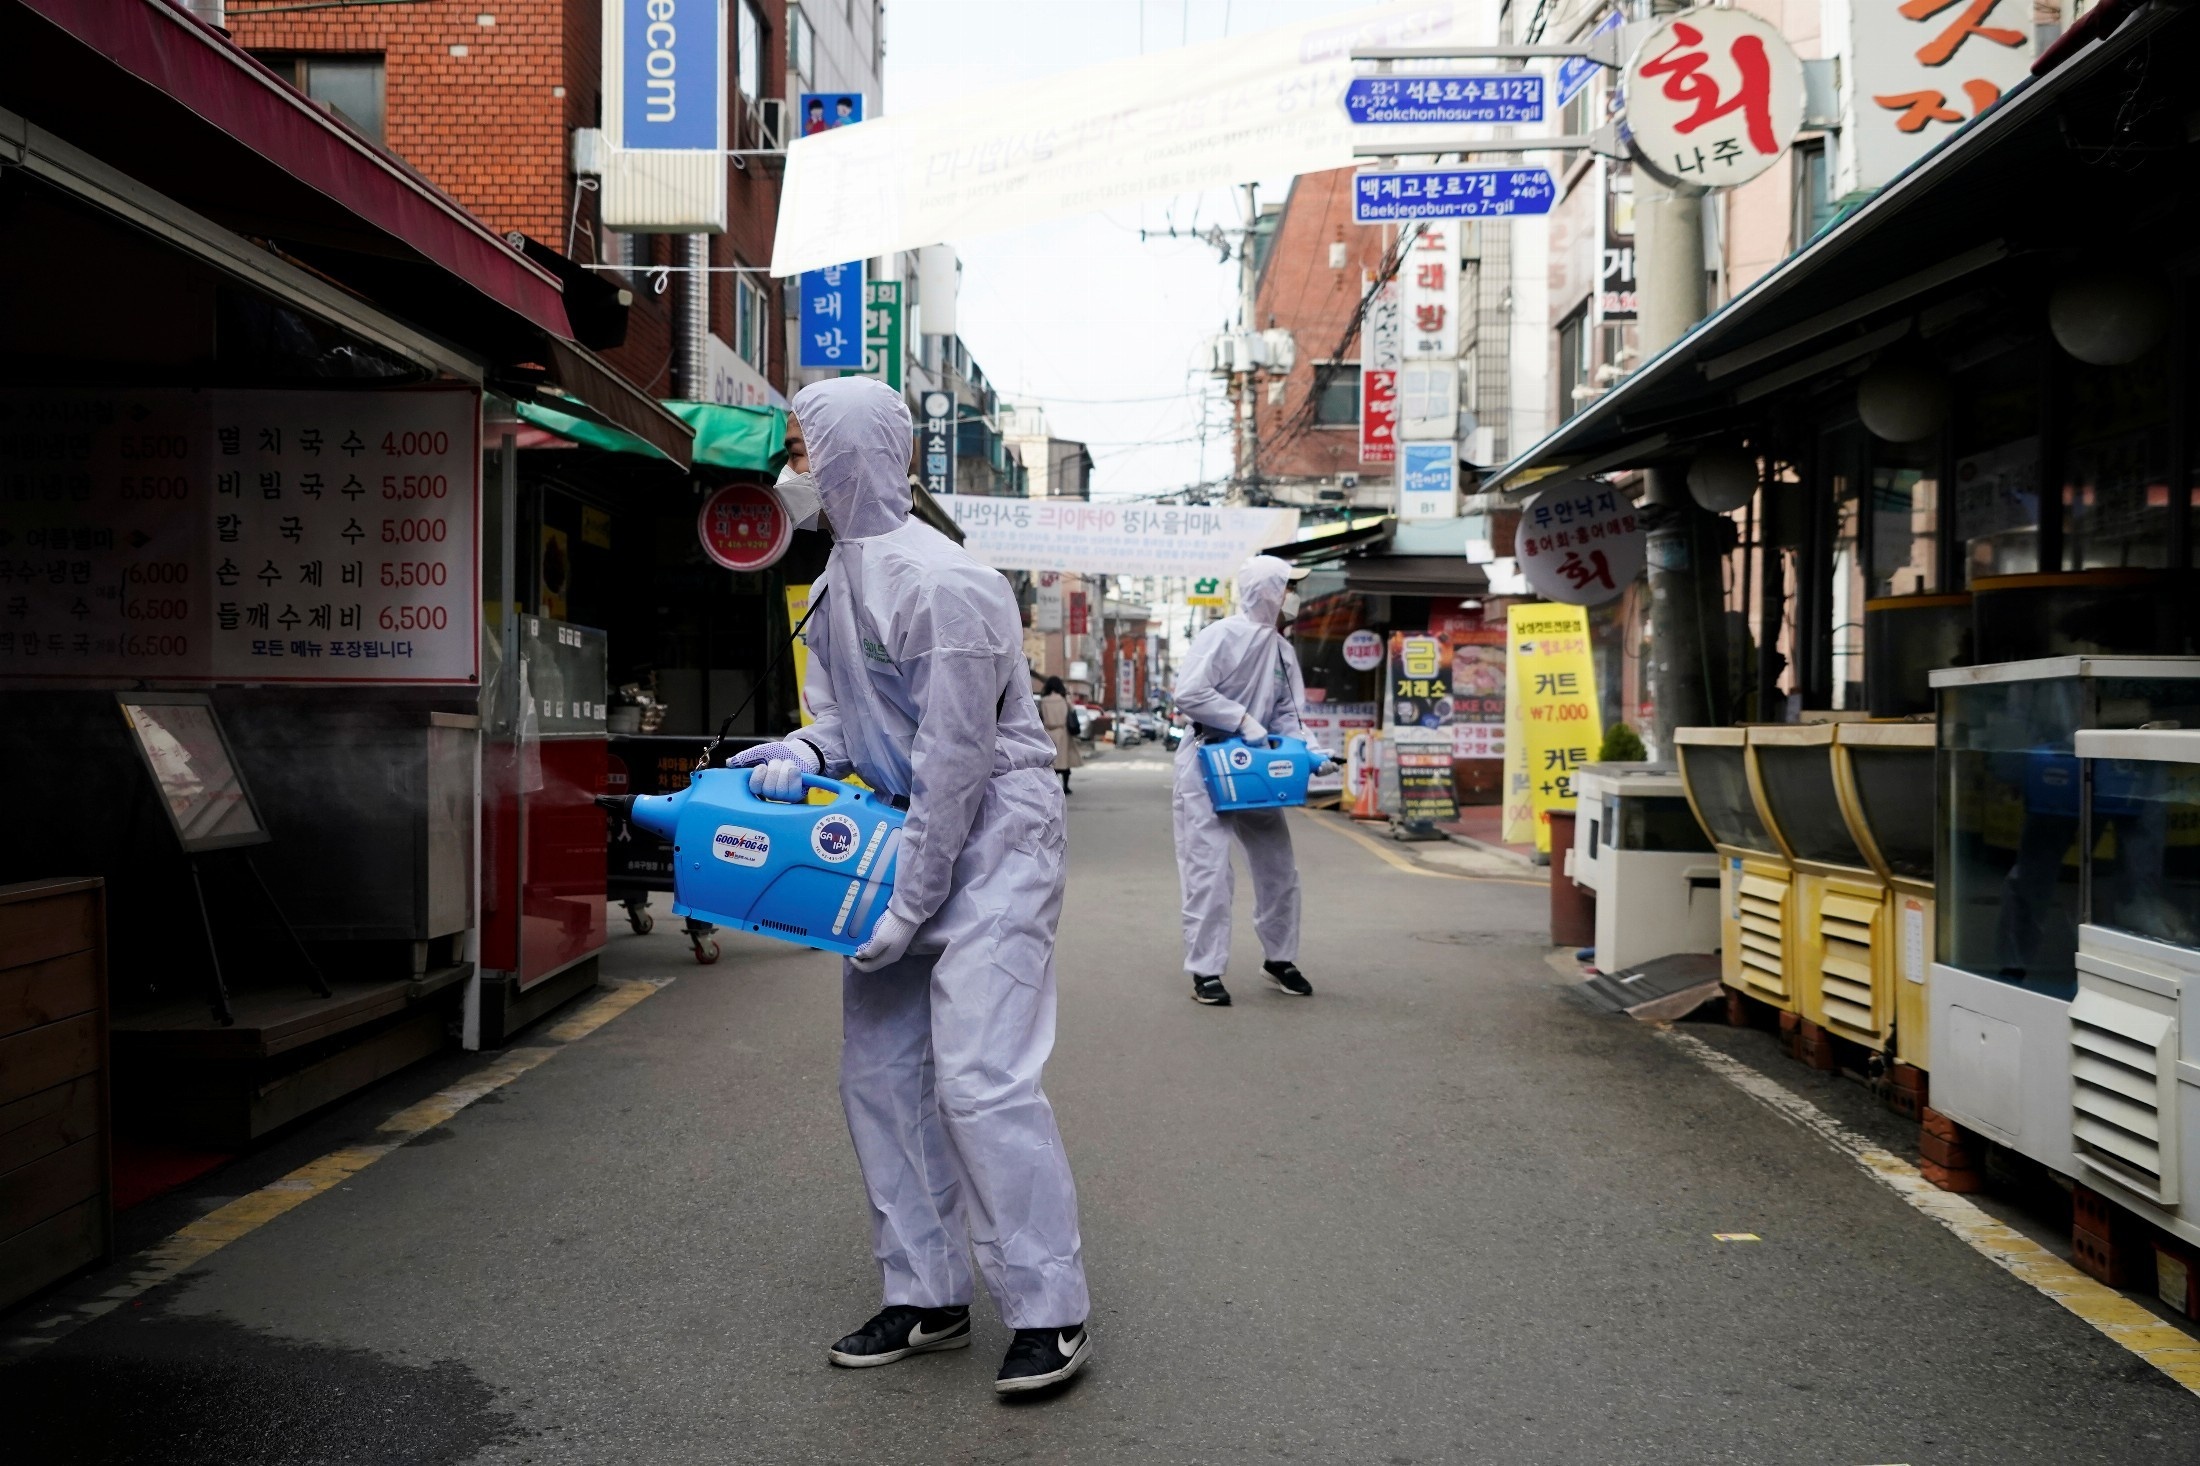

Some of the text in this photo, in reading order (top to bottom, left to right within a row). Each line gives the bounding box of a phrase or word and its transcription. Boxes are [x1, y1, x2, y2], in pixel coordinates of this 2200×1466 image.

[1371, 81, 1399, 94] 23-1
[1406, 80, 1540, 104] 석촌호수로12길
[1639, 22, 1778, 155] 회
[1351, 95, 1387, 108] 23-32
[1366, 105, 1539, 122] Seokchonhosu-ro 12-gil
[1675, 138, 1743, 173] 나주
[1360, 173, 1497, 201] 백제고분로7길
[1510, 172, 1548, 186] 40-46
[1360, 199, 1515, 218] Baekjegobun-ro 7-gil
[1416, 230, 1446, 333] 노래방
[120, 435, 189, 461] 5,500
[380, 431, 449, 458] 4,000
[120, 476, 189, 501] 5,500
[381, 475, 448, 502] 5,500
[1534, 490, 1618, 530] 무안낙지
[380, 518, 447, 544] 5,000
[128, 562, 189, 584] 6,000
[380, 562, 447, 588] 5,500
[1556, 549, 1616, 591] 회
[127, 599, 189, 621] 6,500
[379, 606, 448, 631] 6,500
[127, 635, 189, 657] 6,500
[251, 640, 413, 658] 모든 메뉴 포장됩니다
[1406, 641, 1436, 675] 금
[1397, 680, 1447, 698] 거래소
[1534, 672, 1579, 695] 커트
[1453, 700, 1480, 712] AKE
[1544, 748, 1587, 771] 커트
[716, 834, 769, 852] GOOD FOG 48
[832, 841, 849, 851] IPM
